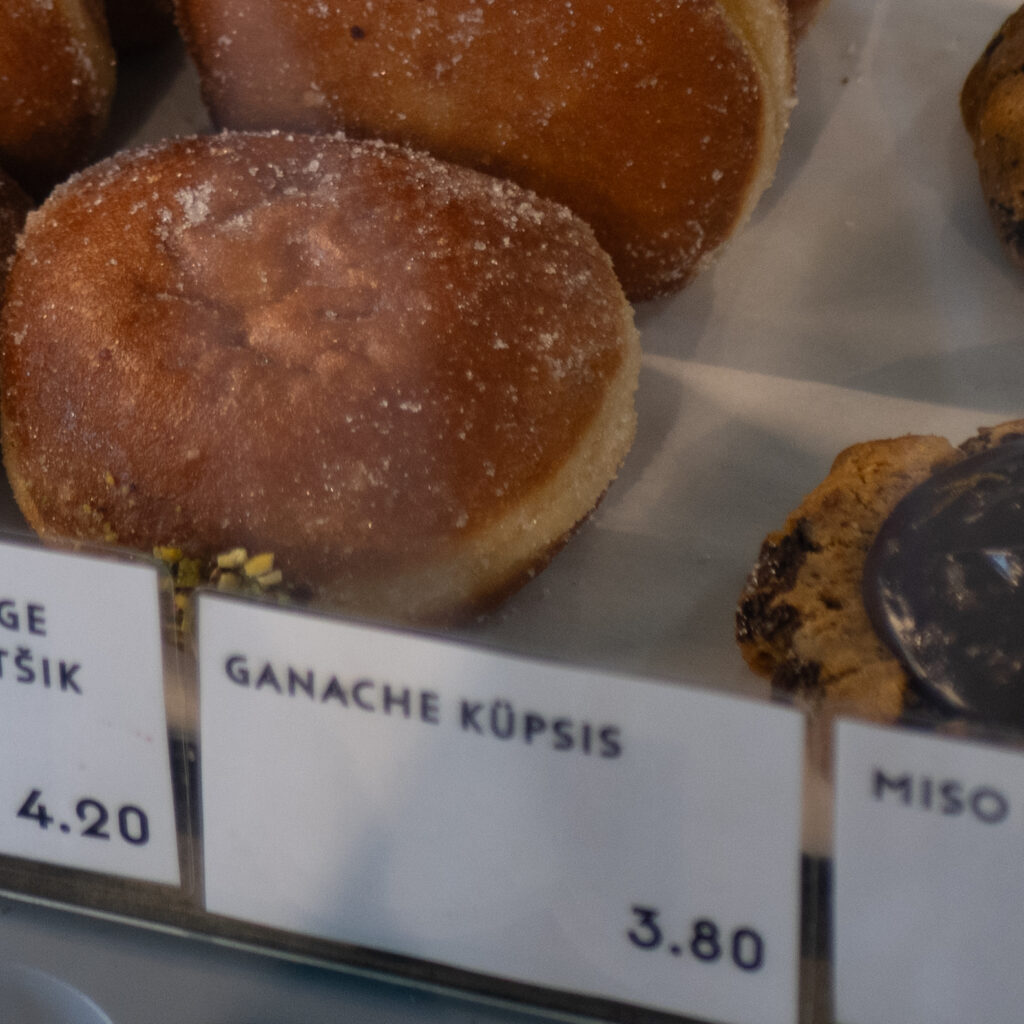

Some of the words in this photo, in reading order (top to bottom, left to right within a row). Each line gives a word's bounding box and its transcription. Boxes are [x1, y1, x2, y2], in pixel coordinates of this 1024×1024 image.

[224, 654, 440, 725] GANACHE
[460, 699, 623, 760] KÜPSIS
[16, 788, 150, 847] 4.20
[870, 768, 1010, 825] MISO
[626, 905, 765, 973] 3.80
